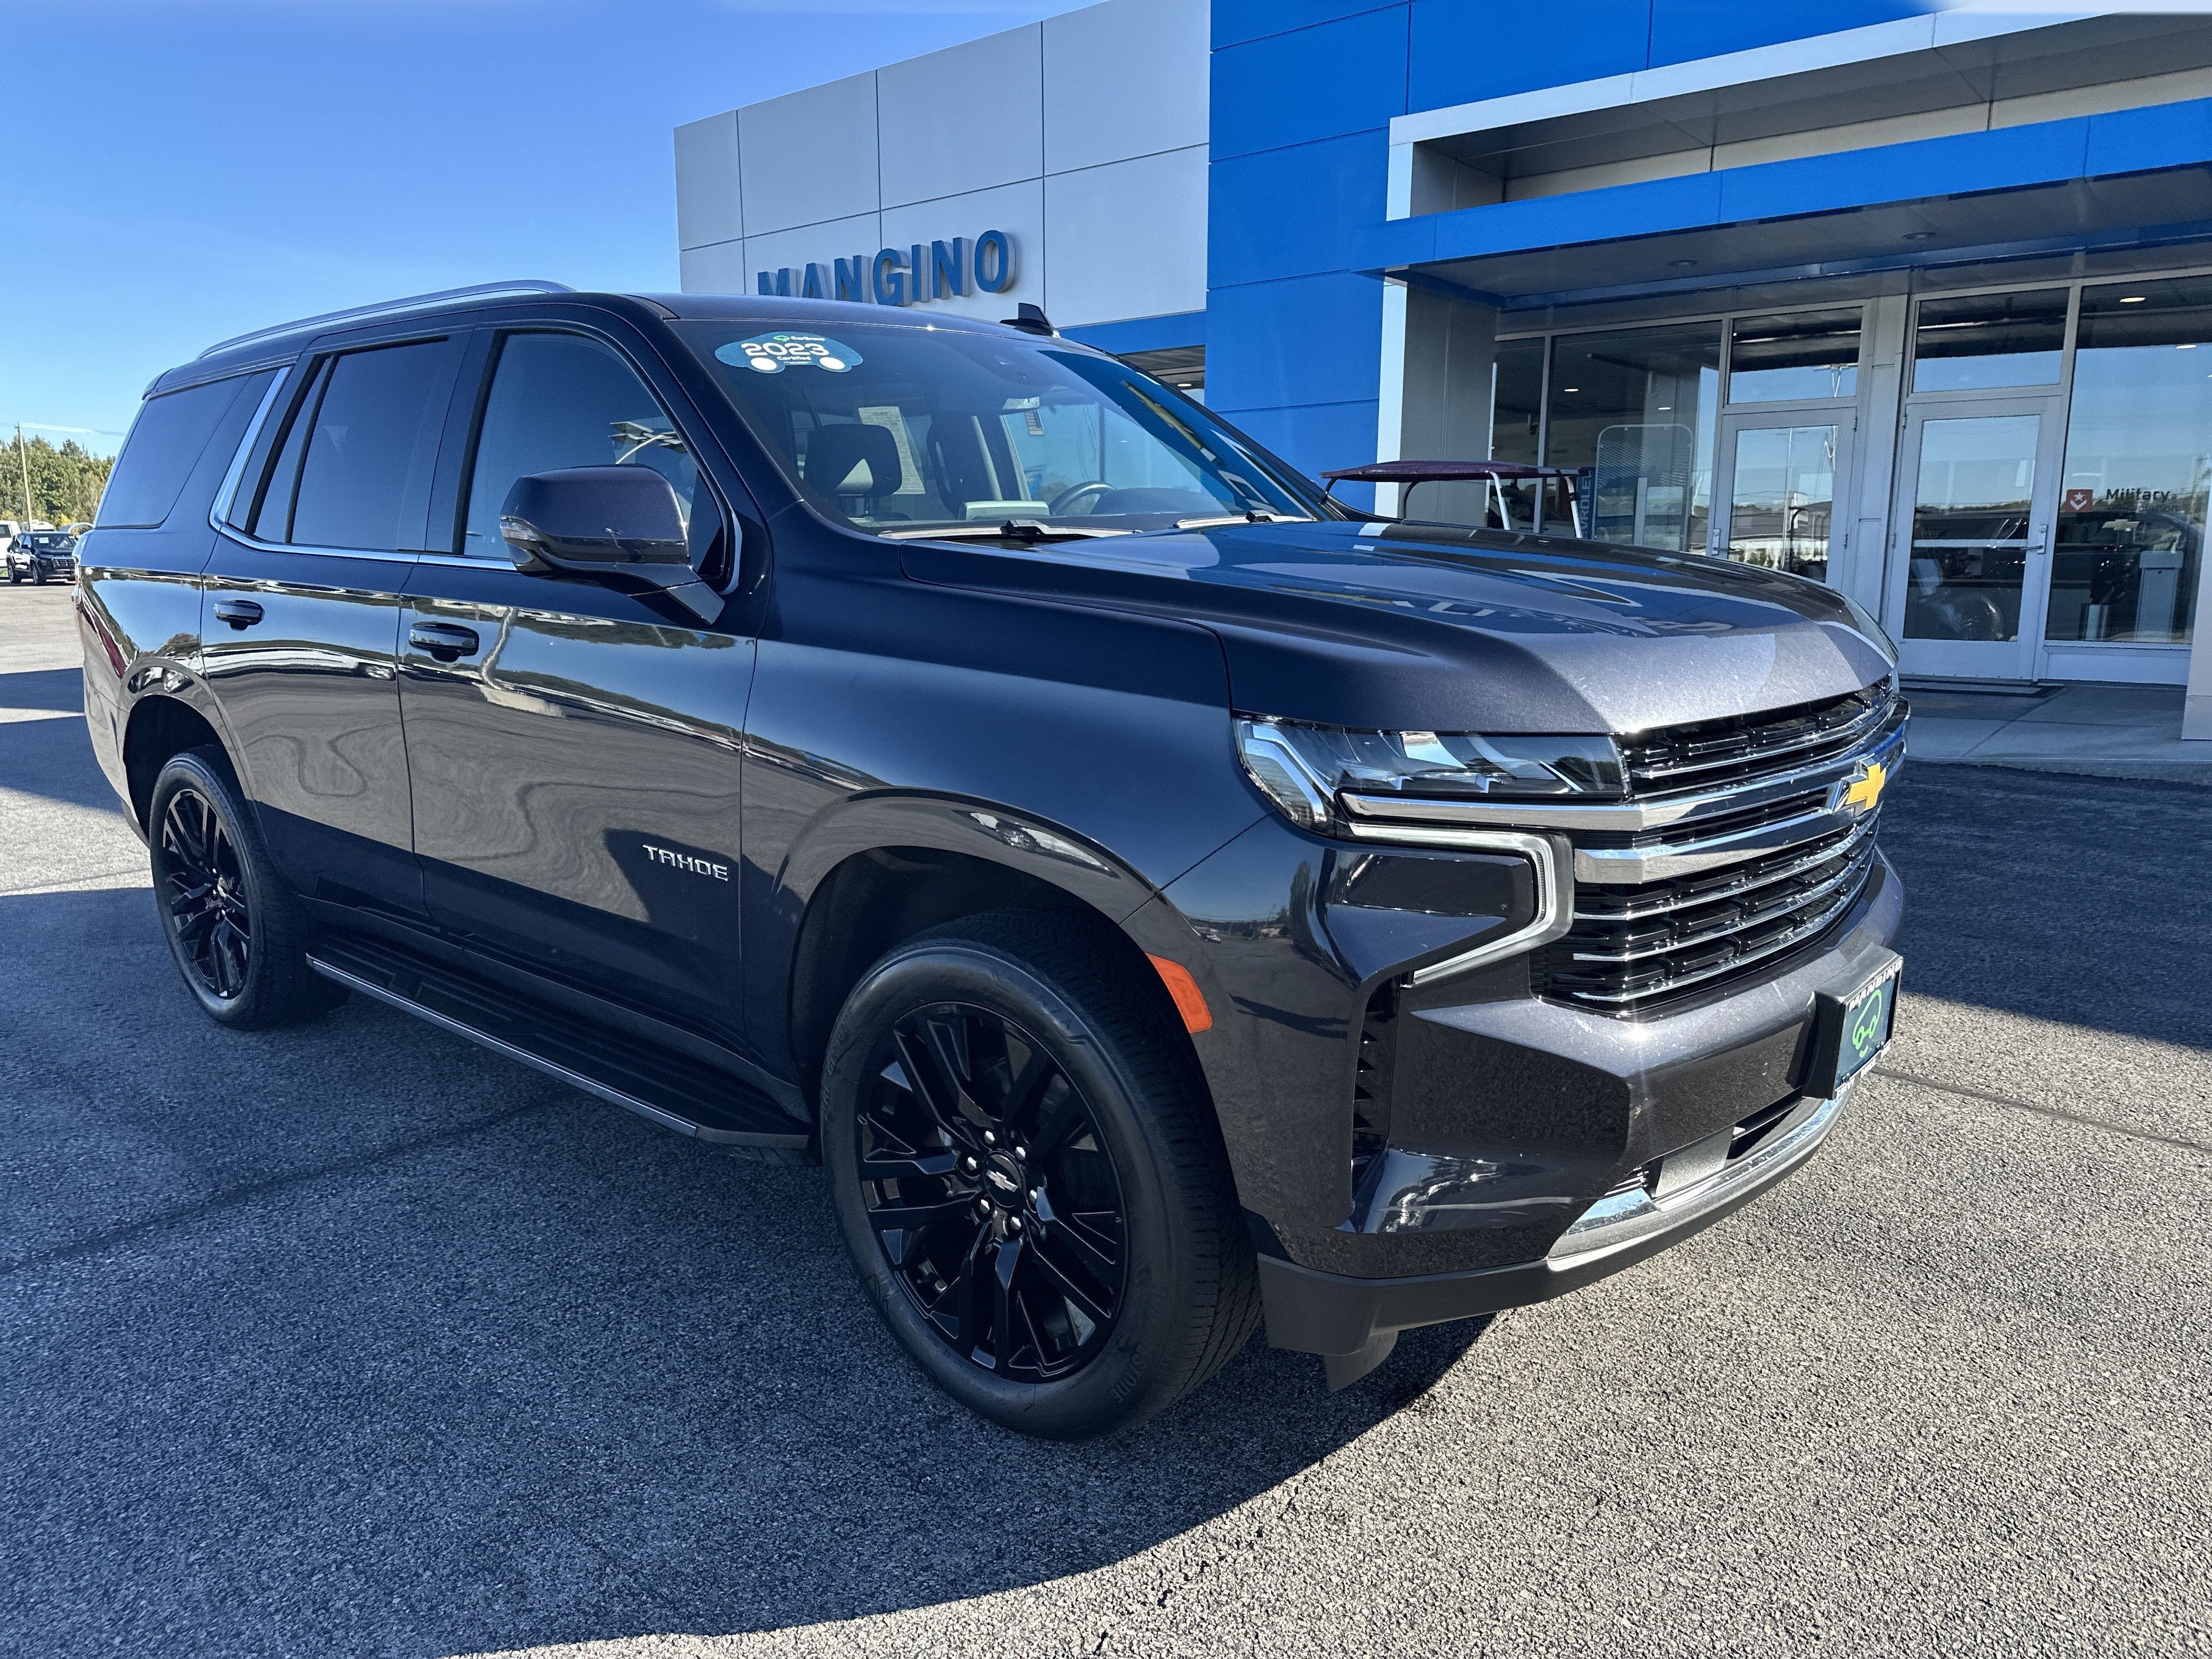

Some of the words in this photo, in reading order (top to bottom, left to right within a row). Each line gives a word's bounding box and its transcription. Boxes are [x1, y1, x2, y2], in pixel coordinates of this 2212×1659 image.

[758, 230, 1014, 306] MANGINO
[741, 342, 829, 356] 2023
[2106, 488, 2171, 503] Military
[642, 845, 728, 881] TAHOE
[1848, 959, 1903, 1012] MANGINO
